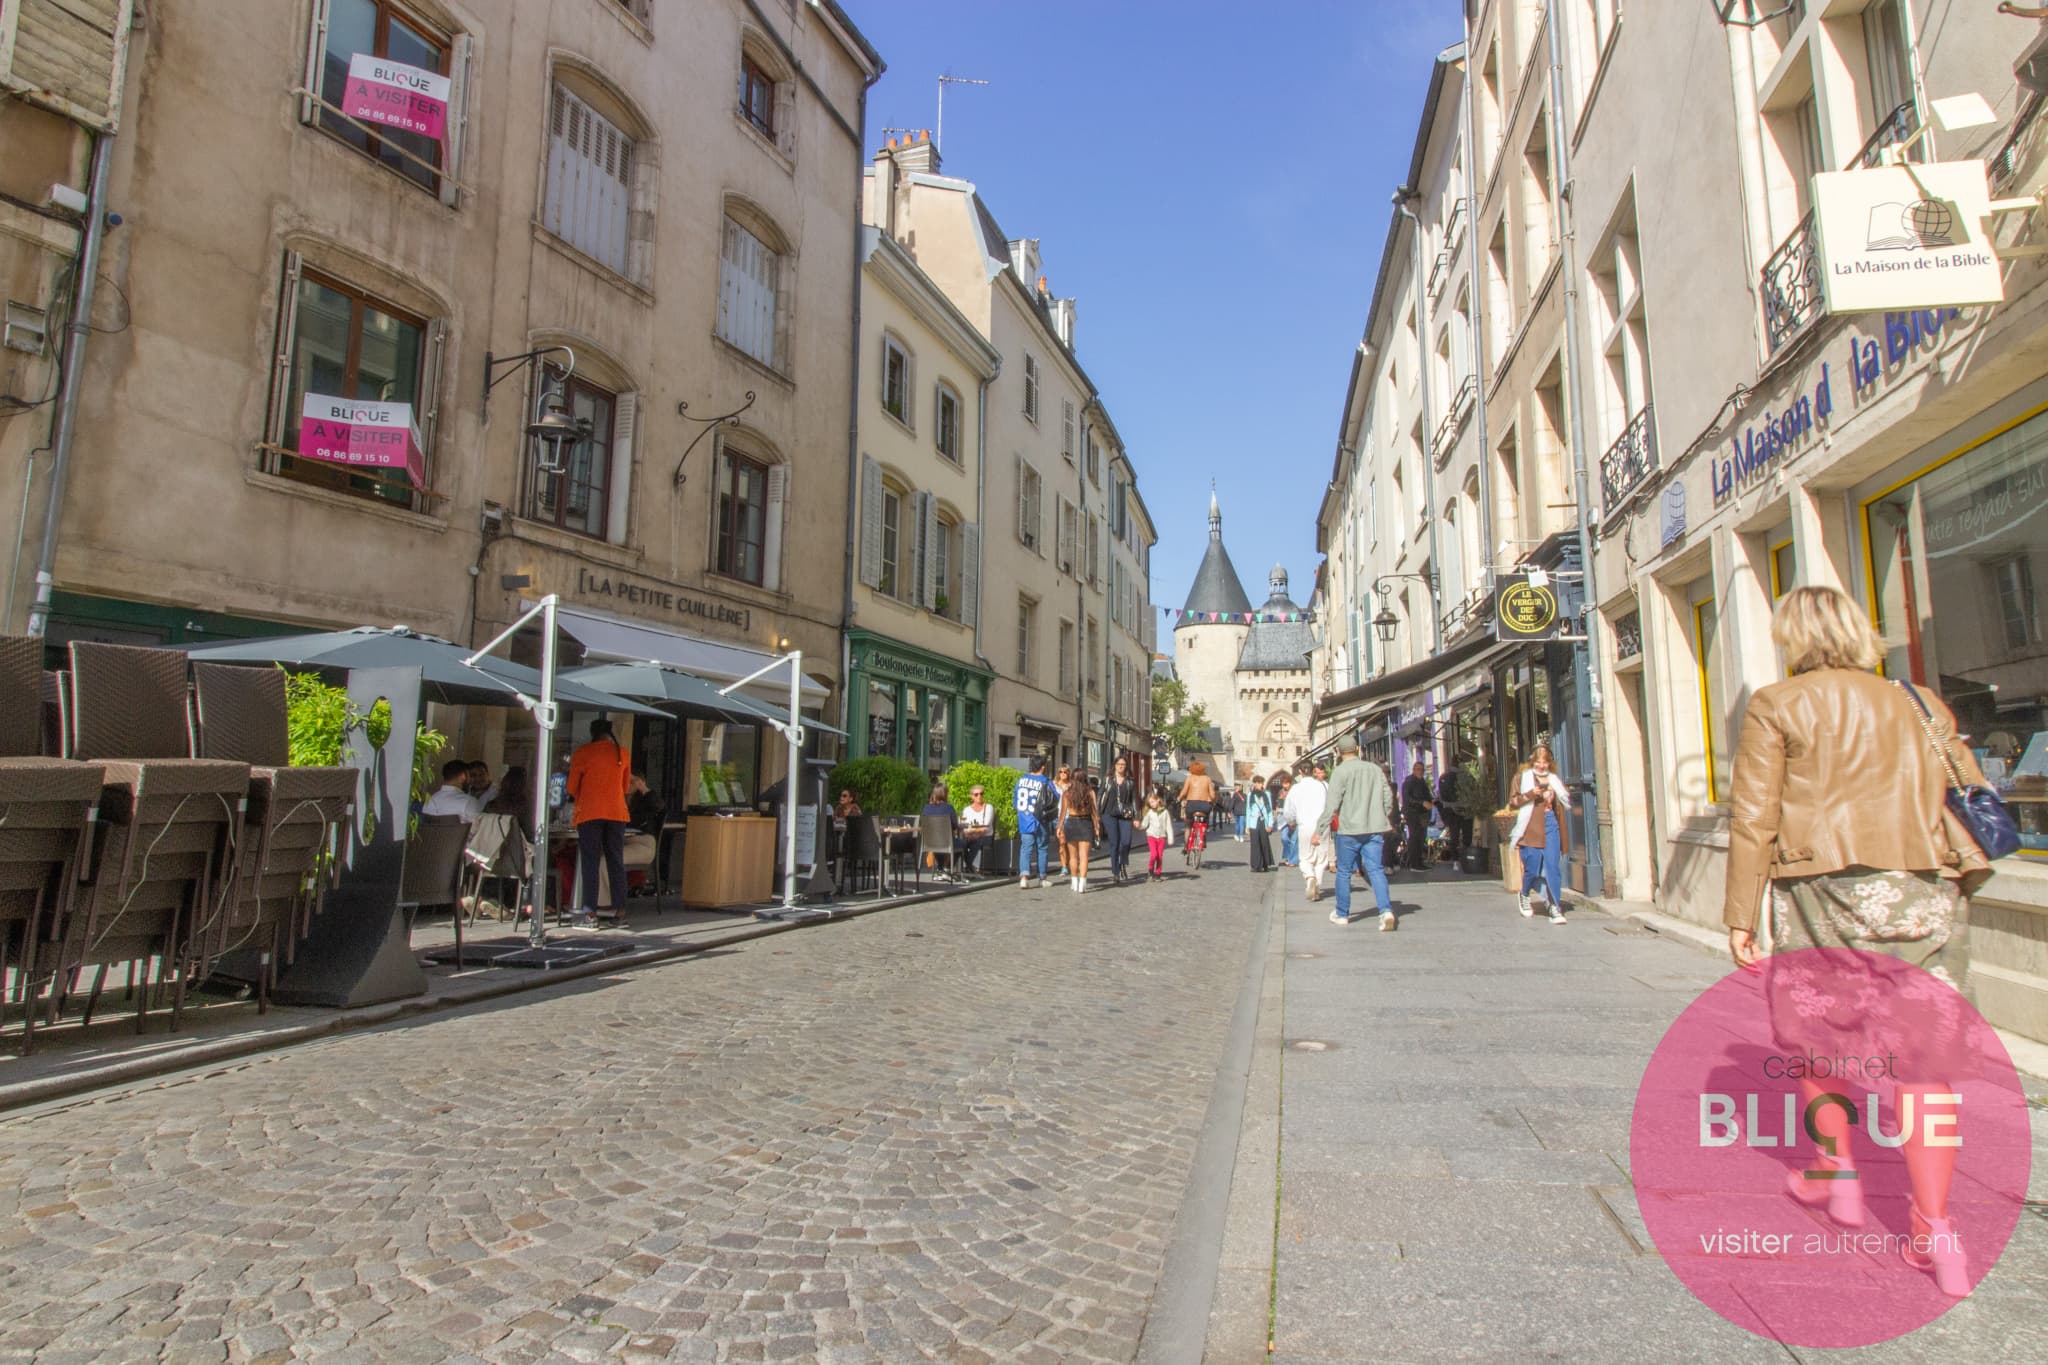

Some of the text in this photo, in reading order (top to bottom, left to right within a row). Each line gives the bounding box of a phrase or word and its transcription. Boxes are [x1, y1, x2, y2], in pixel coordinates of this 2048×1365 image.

[373, 67, 431, 91] BLIQUE
[375, 87, 441, 117] VISITER
[358, 107, 371, 117] 06
[402, 117, 413, 128] 15
[415, 121, 427, 132] 10
[1835, 252, 1991, 275] La Maison de la Bible
[331, 406, 391, 422] BLIQUE
[1711, 458, 1733, 498] La
[1733, 394, 1813, 483] Maison
[1850, 336, 1882, 392] la
[333, 426, 403, 444] VISITER
[316, 448, 331, 458] 06
[365, 454, 376, 462] 15
[379, 455, 390, 463] 10
[617, 581, 673, 609] PETITE
